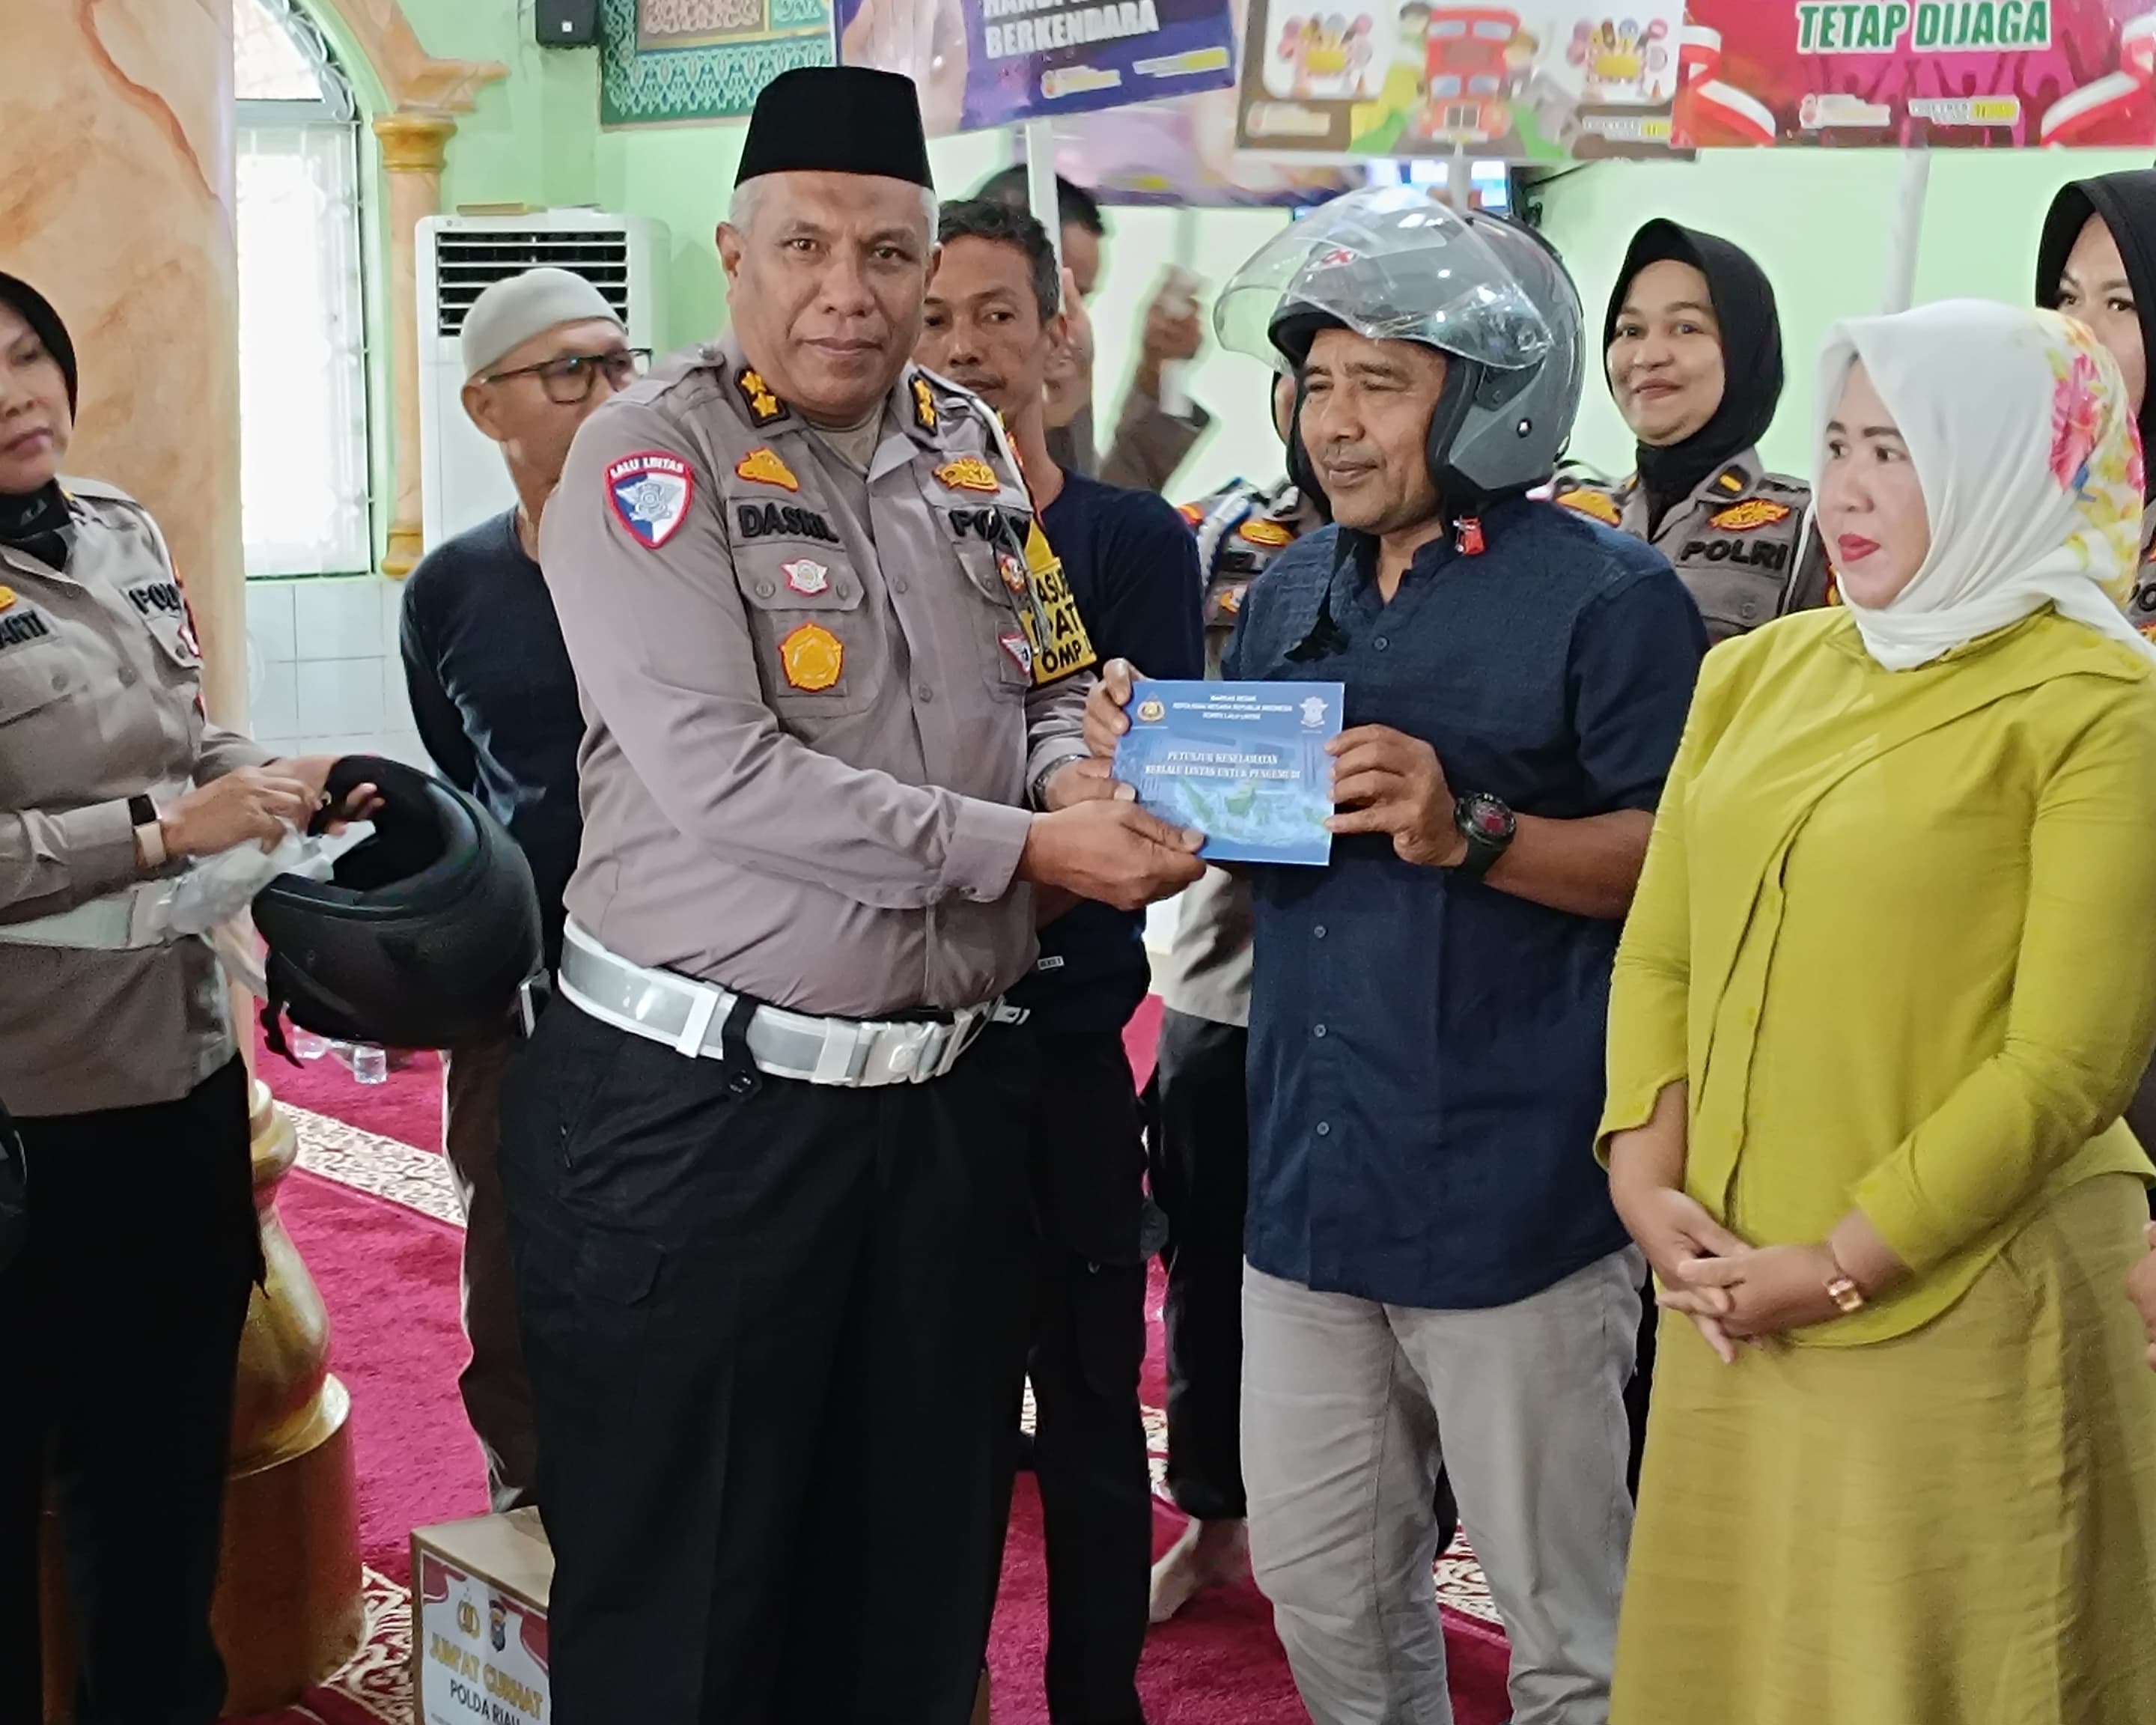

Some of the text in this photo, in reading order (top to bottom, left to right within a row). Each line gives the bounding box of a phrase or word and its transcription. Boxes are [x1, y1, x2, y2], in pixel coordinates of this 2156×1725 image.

[984, 0, 1160, 59] BERKENDARA
[1799, 1, 2050, 49] TETAP DIJAGA
[609, 458, 639, 478] LALU
[1681, 538, 1788, 571] POLRI
[129, 582, 182, 615] POL
[1184, 766, 1216, 776] LINTAS
[1215, 752, 1278, 764] KESELAMATAN
[450, 1679, 490, 1721] POLDA
